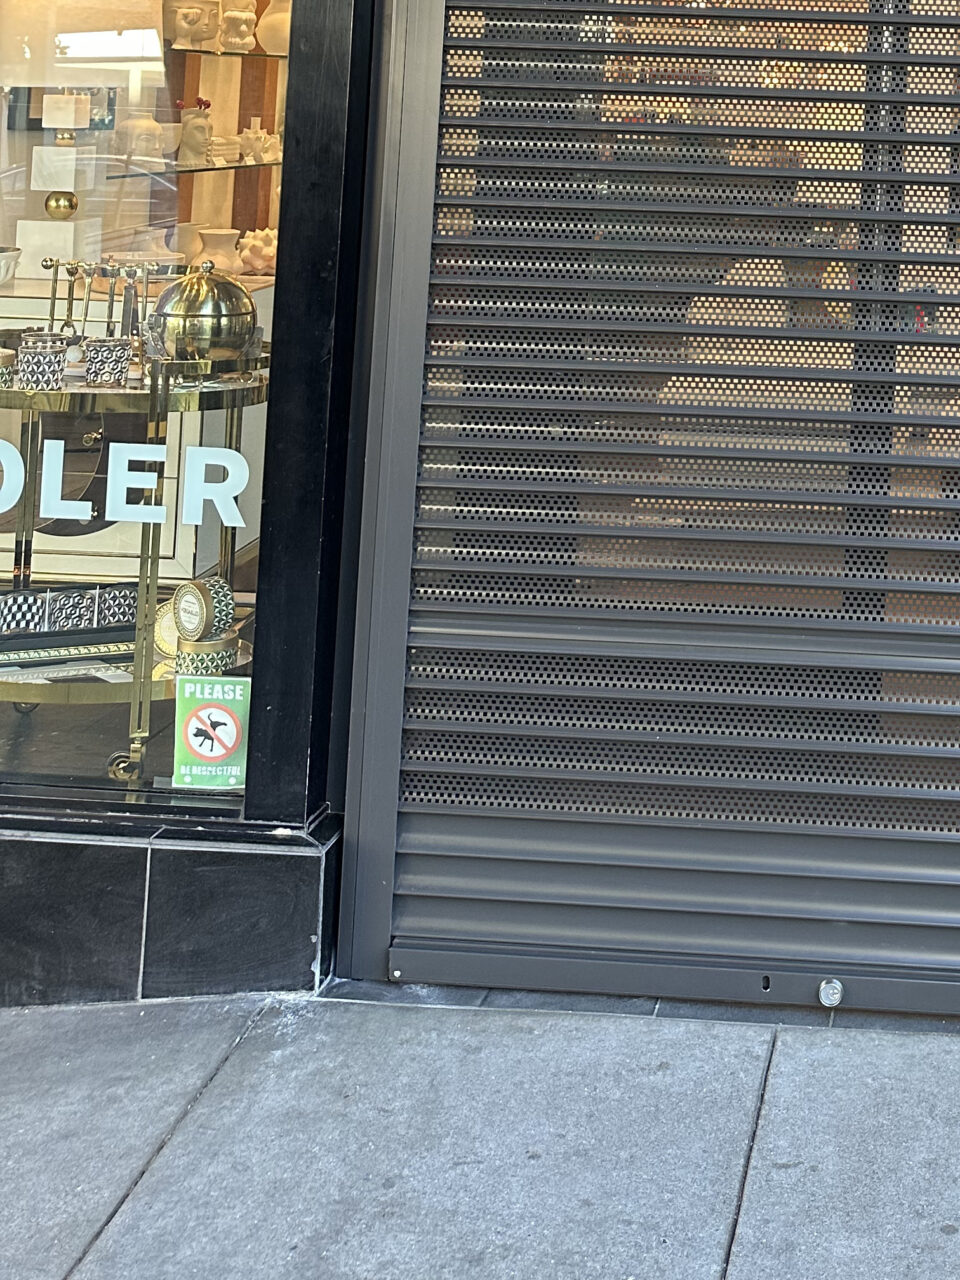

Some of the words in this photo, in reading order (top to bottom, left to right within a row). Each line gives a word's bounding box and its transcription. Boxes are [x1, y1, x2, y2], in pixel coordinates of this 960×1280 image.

[184, 682, 244, 701] PLEASE
[180, 765, 191, 775] BE
[191, 765, 241, 776] RESPECTFUL
